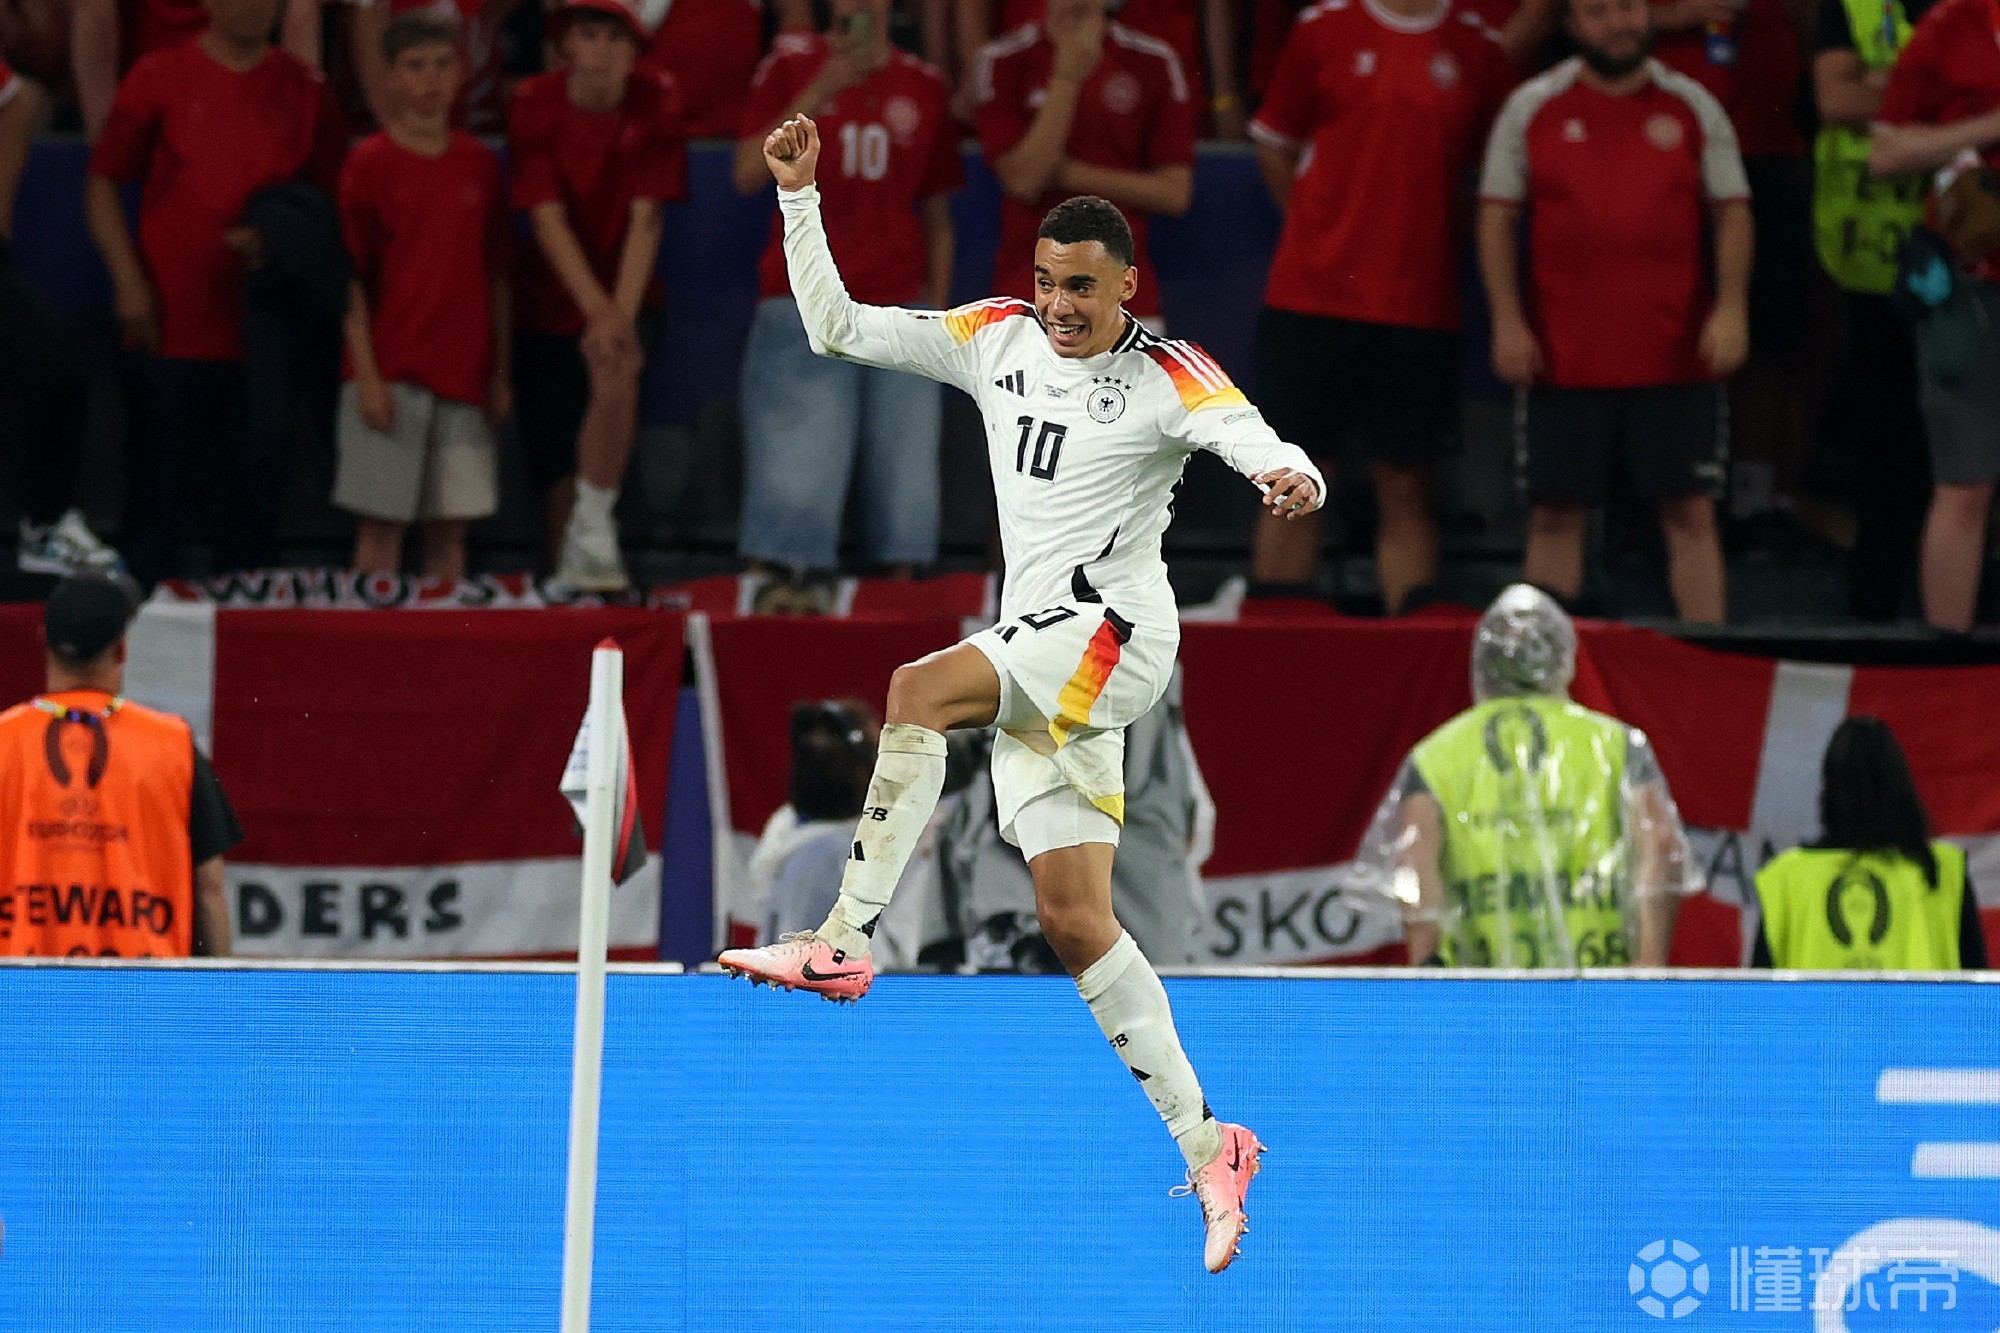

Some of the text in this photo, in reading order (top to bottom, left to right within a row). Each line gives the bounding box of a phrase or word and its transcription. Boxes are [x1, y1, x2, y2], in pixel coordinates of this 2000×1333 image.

[840, 124, 888, 179] 10
[1016, 415, 1069, 484] 10
[0, 885, 173, 936] EWARD
